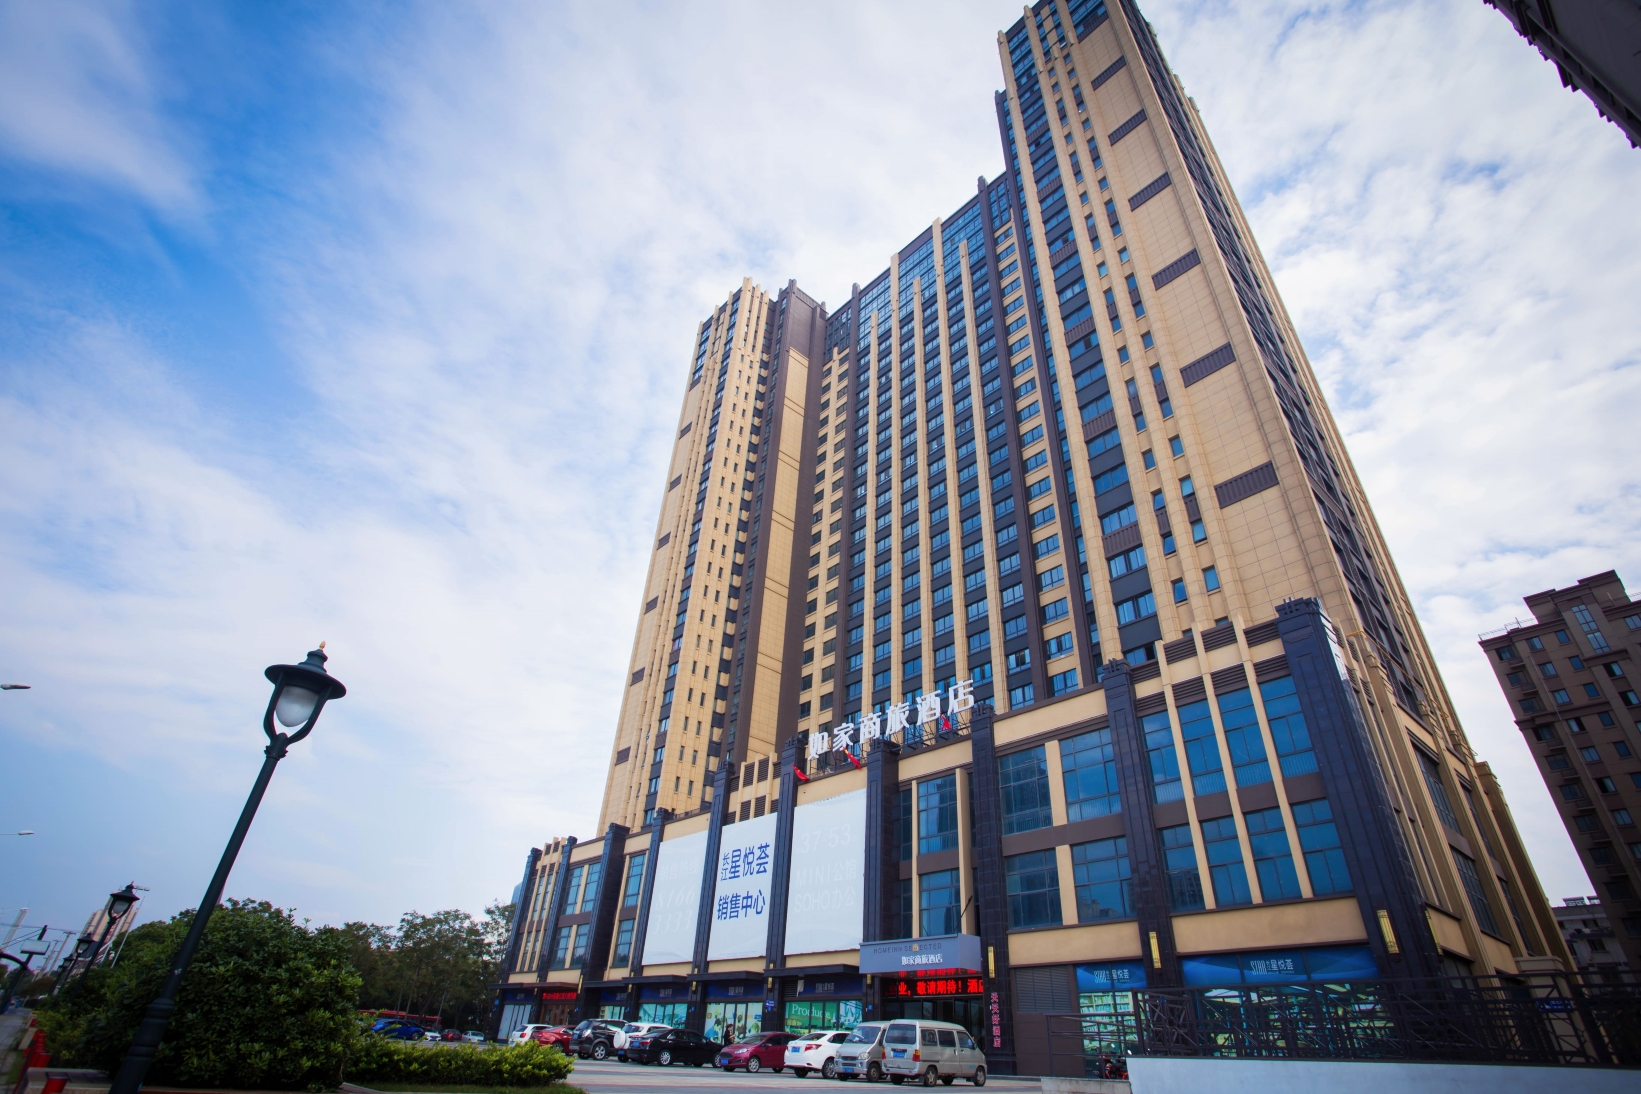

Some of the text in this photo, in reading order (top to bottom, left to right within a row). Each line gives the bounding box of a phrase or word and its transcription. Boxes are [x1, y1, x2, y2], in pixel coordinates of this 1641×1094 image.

[808, 679, 975, 761] 如家商旅酒店
[717, 889, 766, 921] 销售中心
[904, 943, 942, 952] SEECTED
